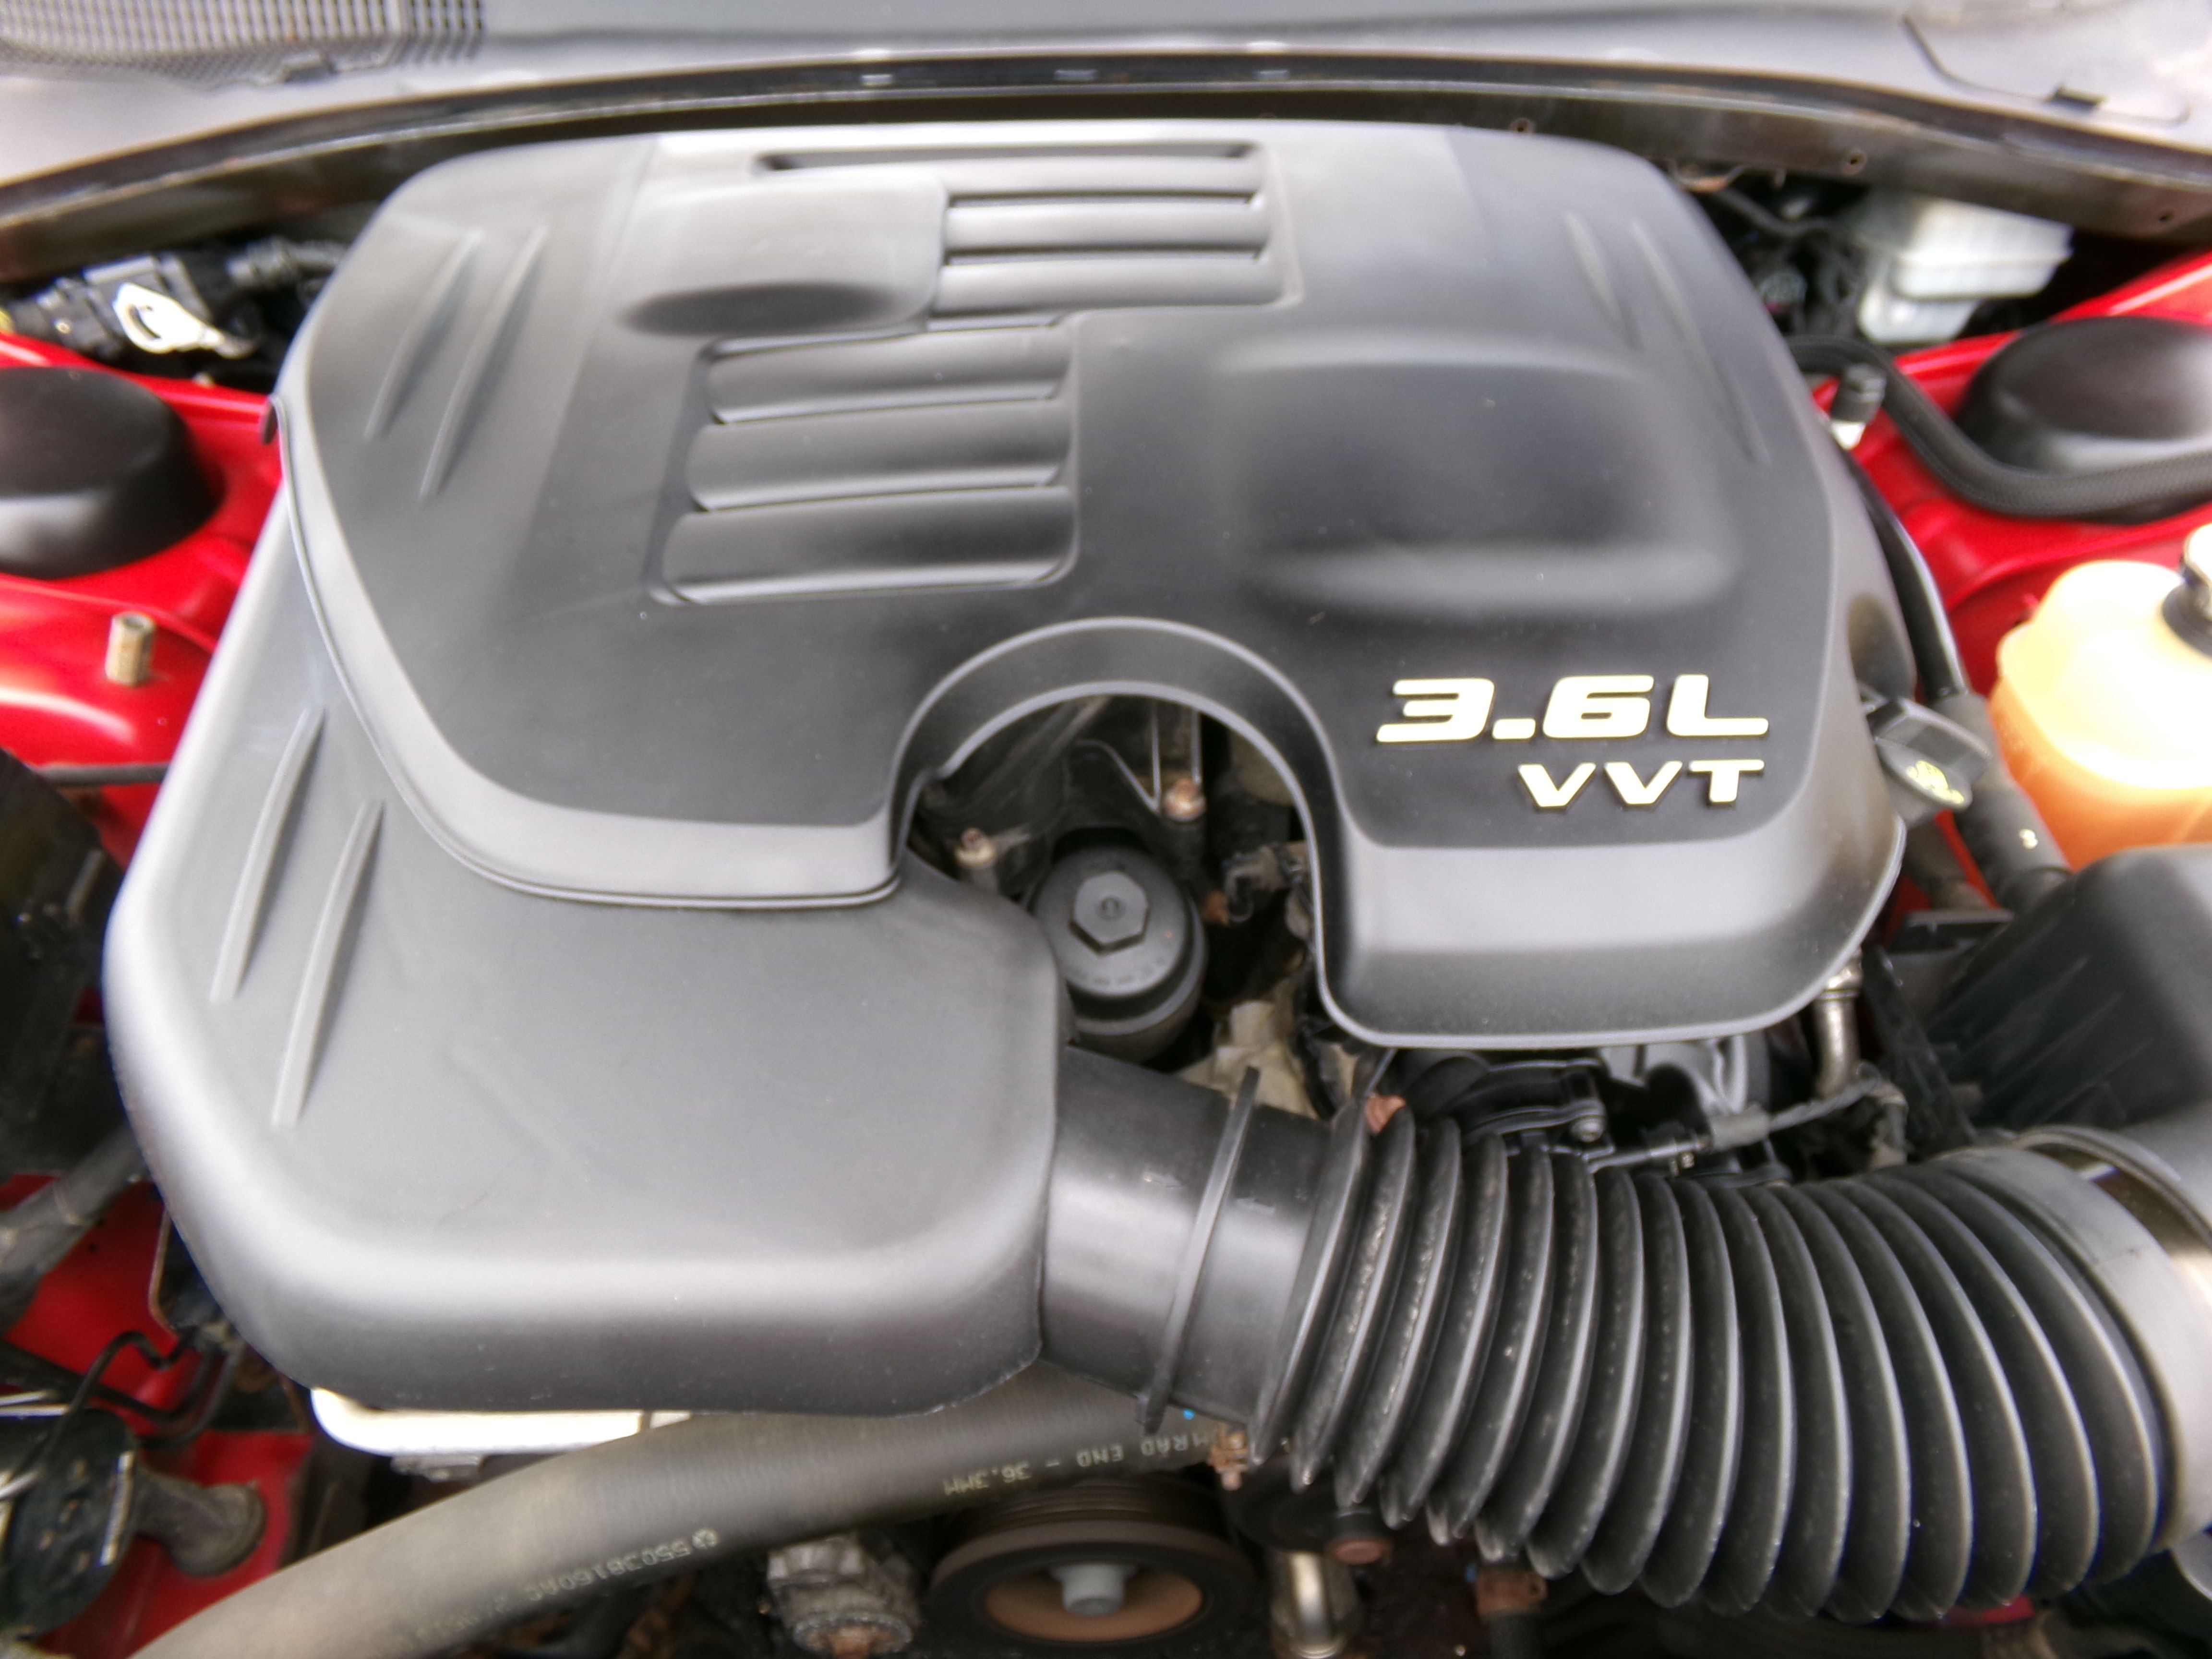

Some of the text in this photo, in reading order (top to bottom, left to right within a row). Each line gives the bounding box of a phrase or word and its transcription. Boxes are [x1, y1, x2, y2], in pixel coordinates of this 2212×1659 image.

[1376, 674, 1769, 744] 3.6L
[1518, 759, 1765, 808] VVT
[1075, 1442, 1124, 1468] END
[943, 1460, 1032, 1496] 36.3MM
